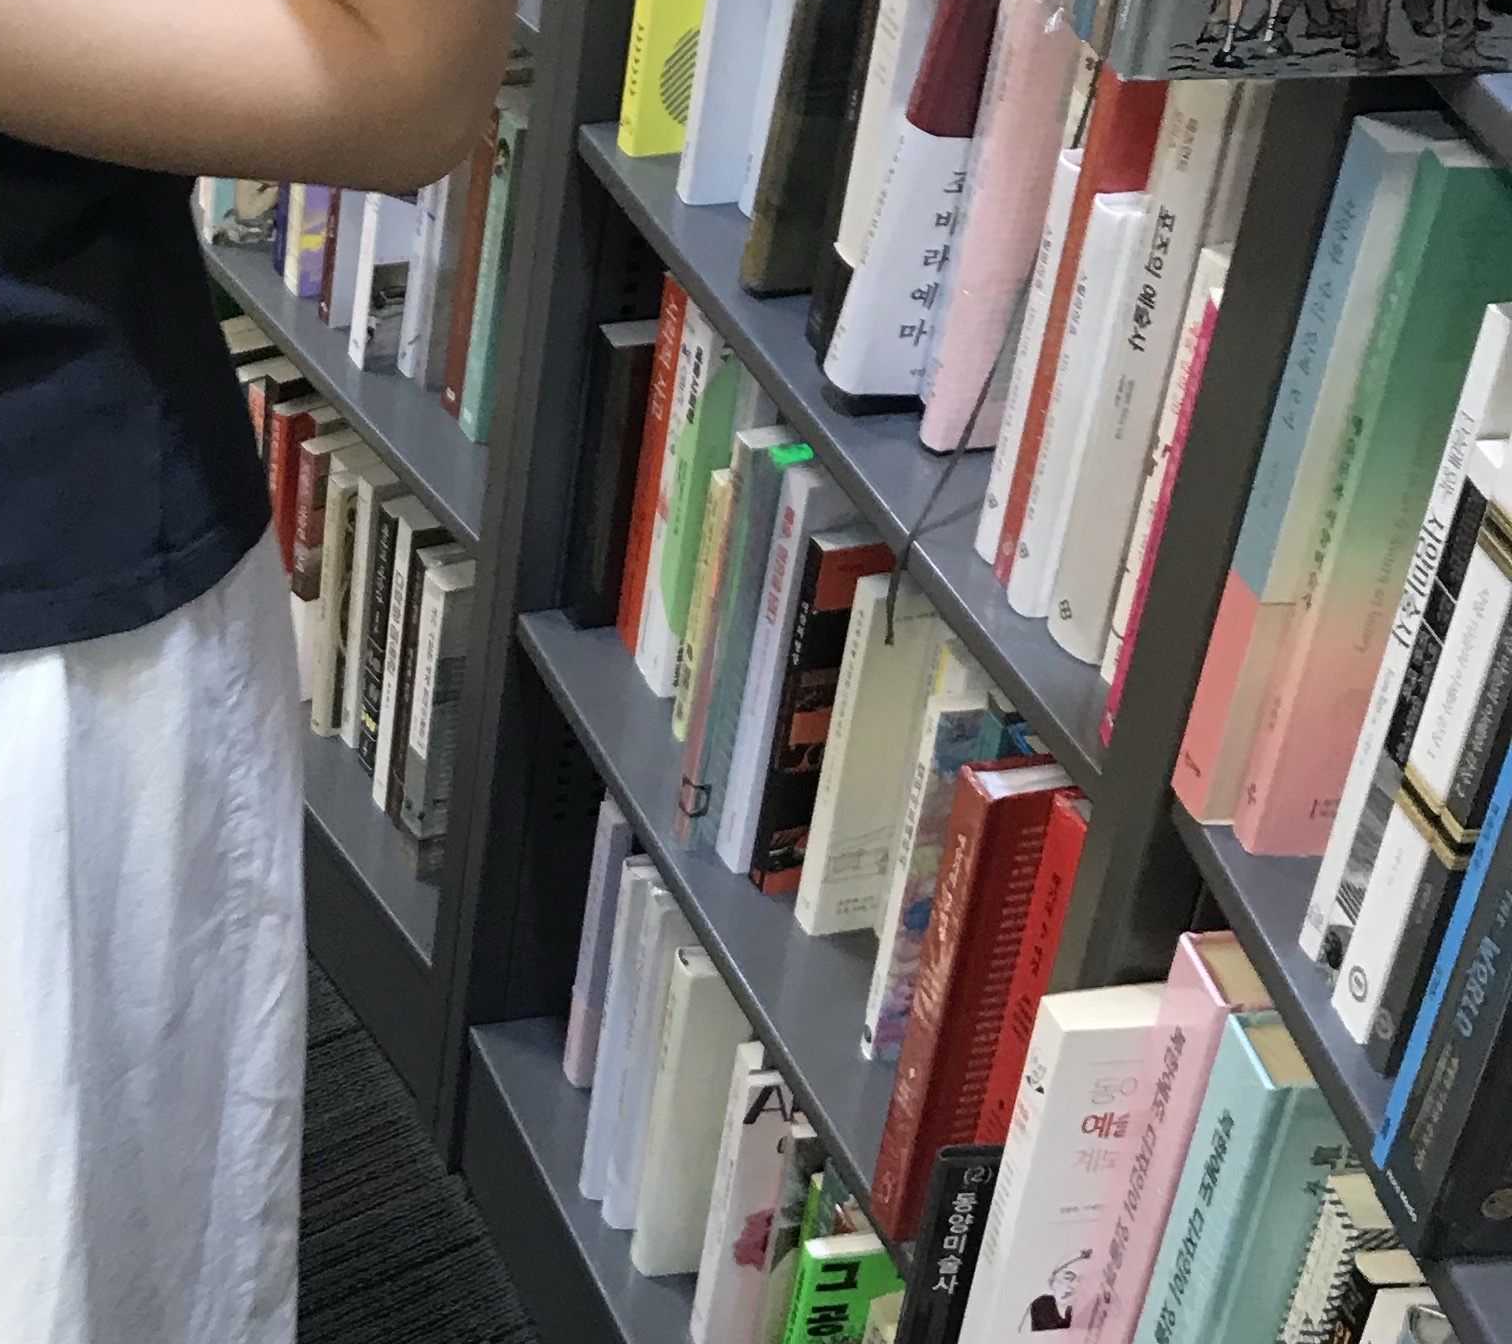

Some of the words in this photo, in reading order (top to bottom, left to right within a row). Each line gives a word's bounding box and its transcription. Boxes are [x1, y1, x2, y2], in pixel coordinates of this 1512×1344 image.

[1153, 1024, 1188, 1125] 북한에도
[1198, 1107, 1235, 1210] 북한에도
[931, 1192, 979, 1296] 동양미술사
[1168, 1210, 1206, 1309] 디자인이
